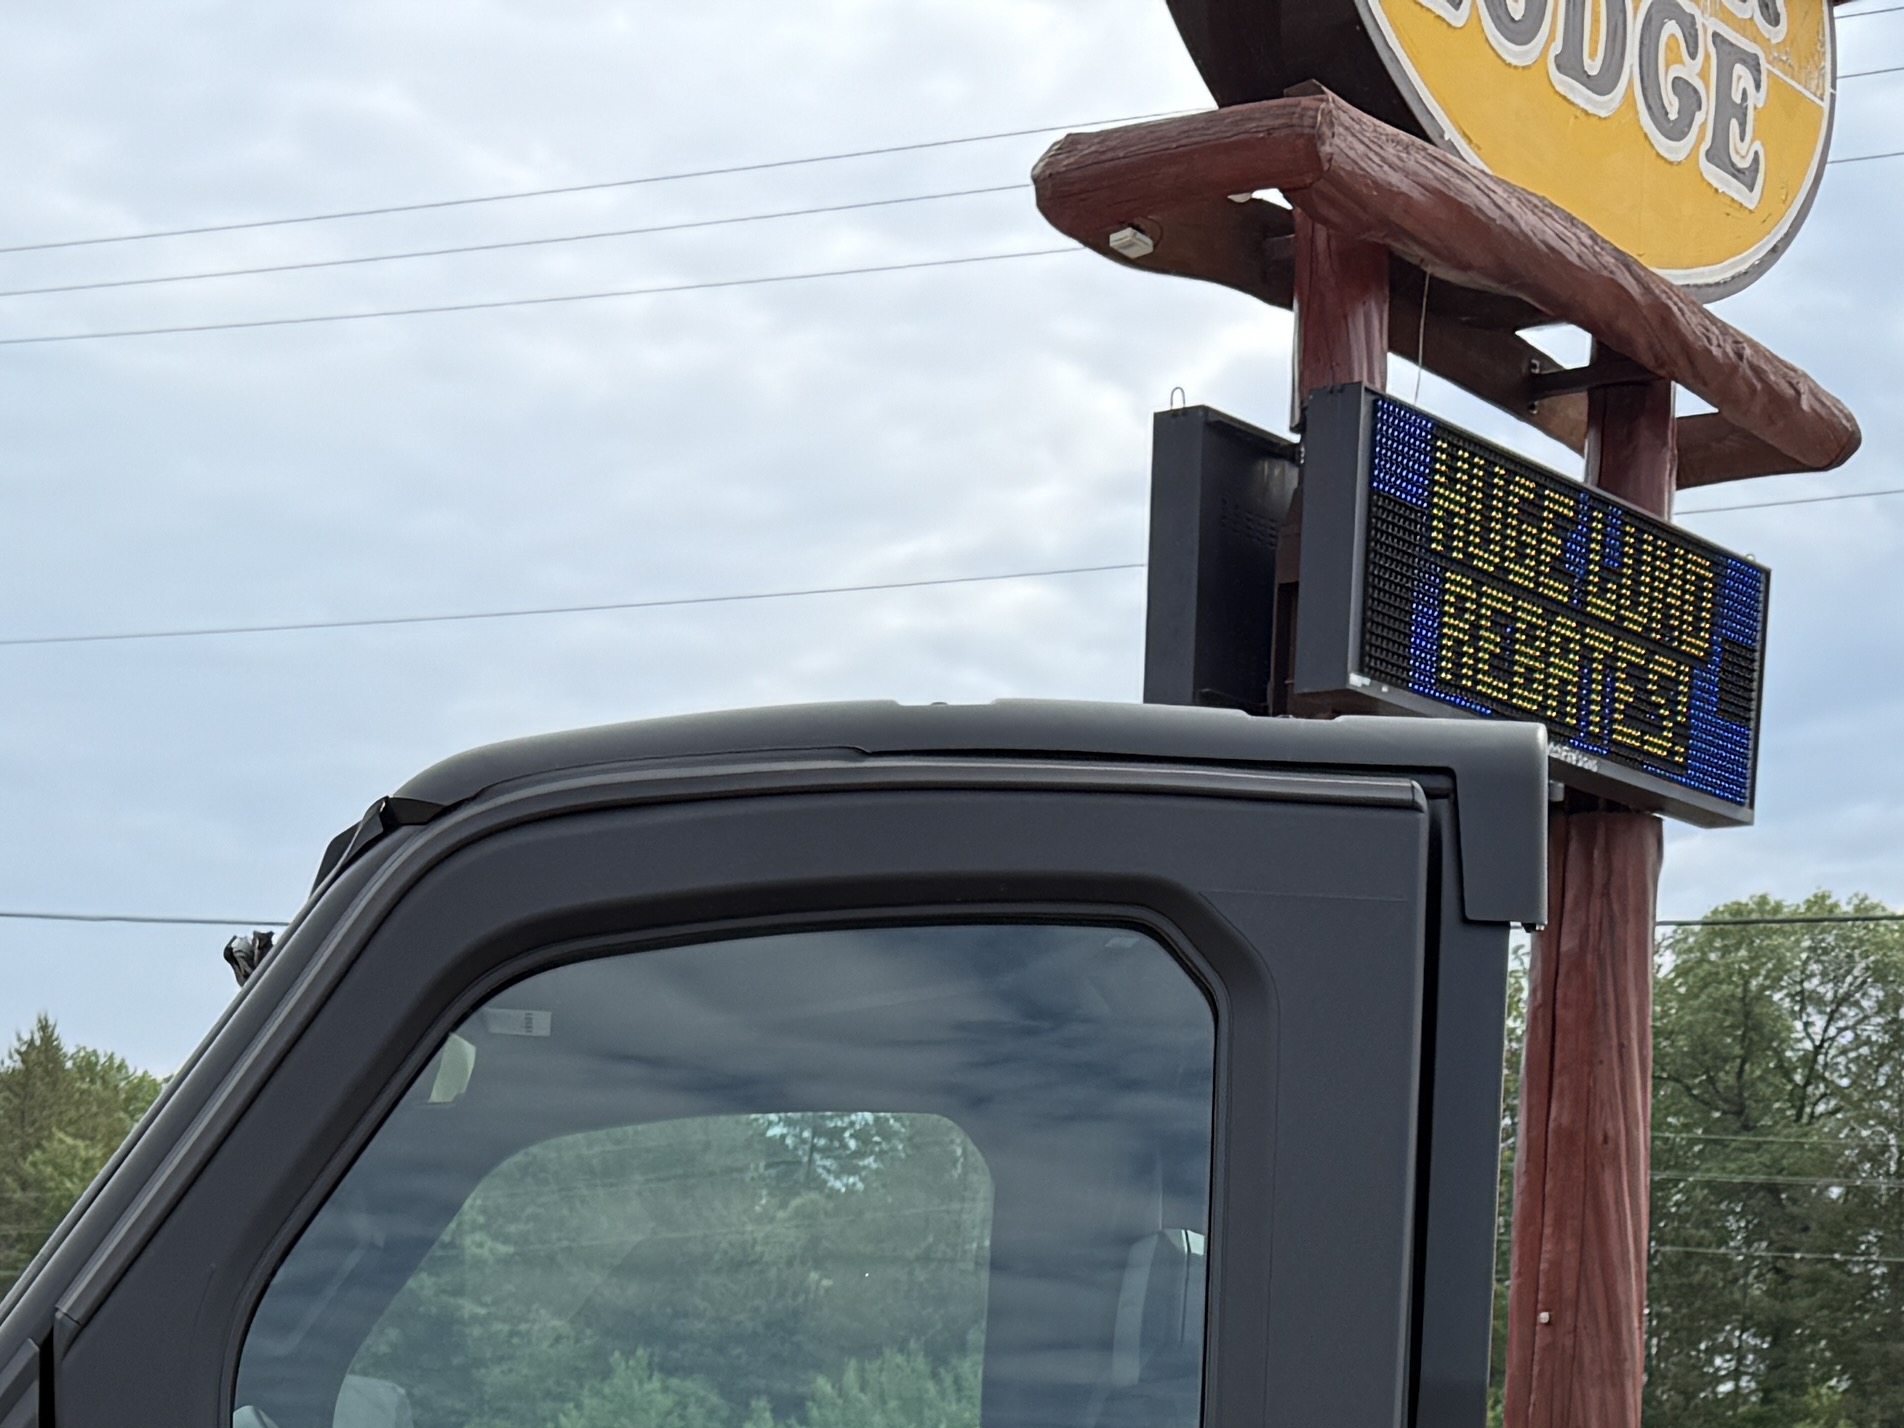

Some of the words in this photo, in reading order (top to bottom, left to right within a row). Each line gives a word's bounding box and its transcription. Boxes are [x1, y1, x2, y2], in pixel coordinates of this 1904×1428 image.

[1421, 0, 1764, 198] DGE
[1431, 440, 1574, 602] HUGE
[1587, 511, 1714, 657] LUND
[1440, 572, 1690, 763] REBATES!
